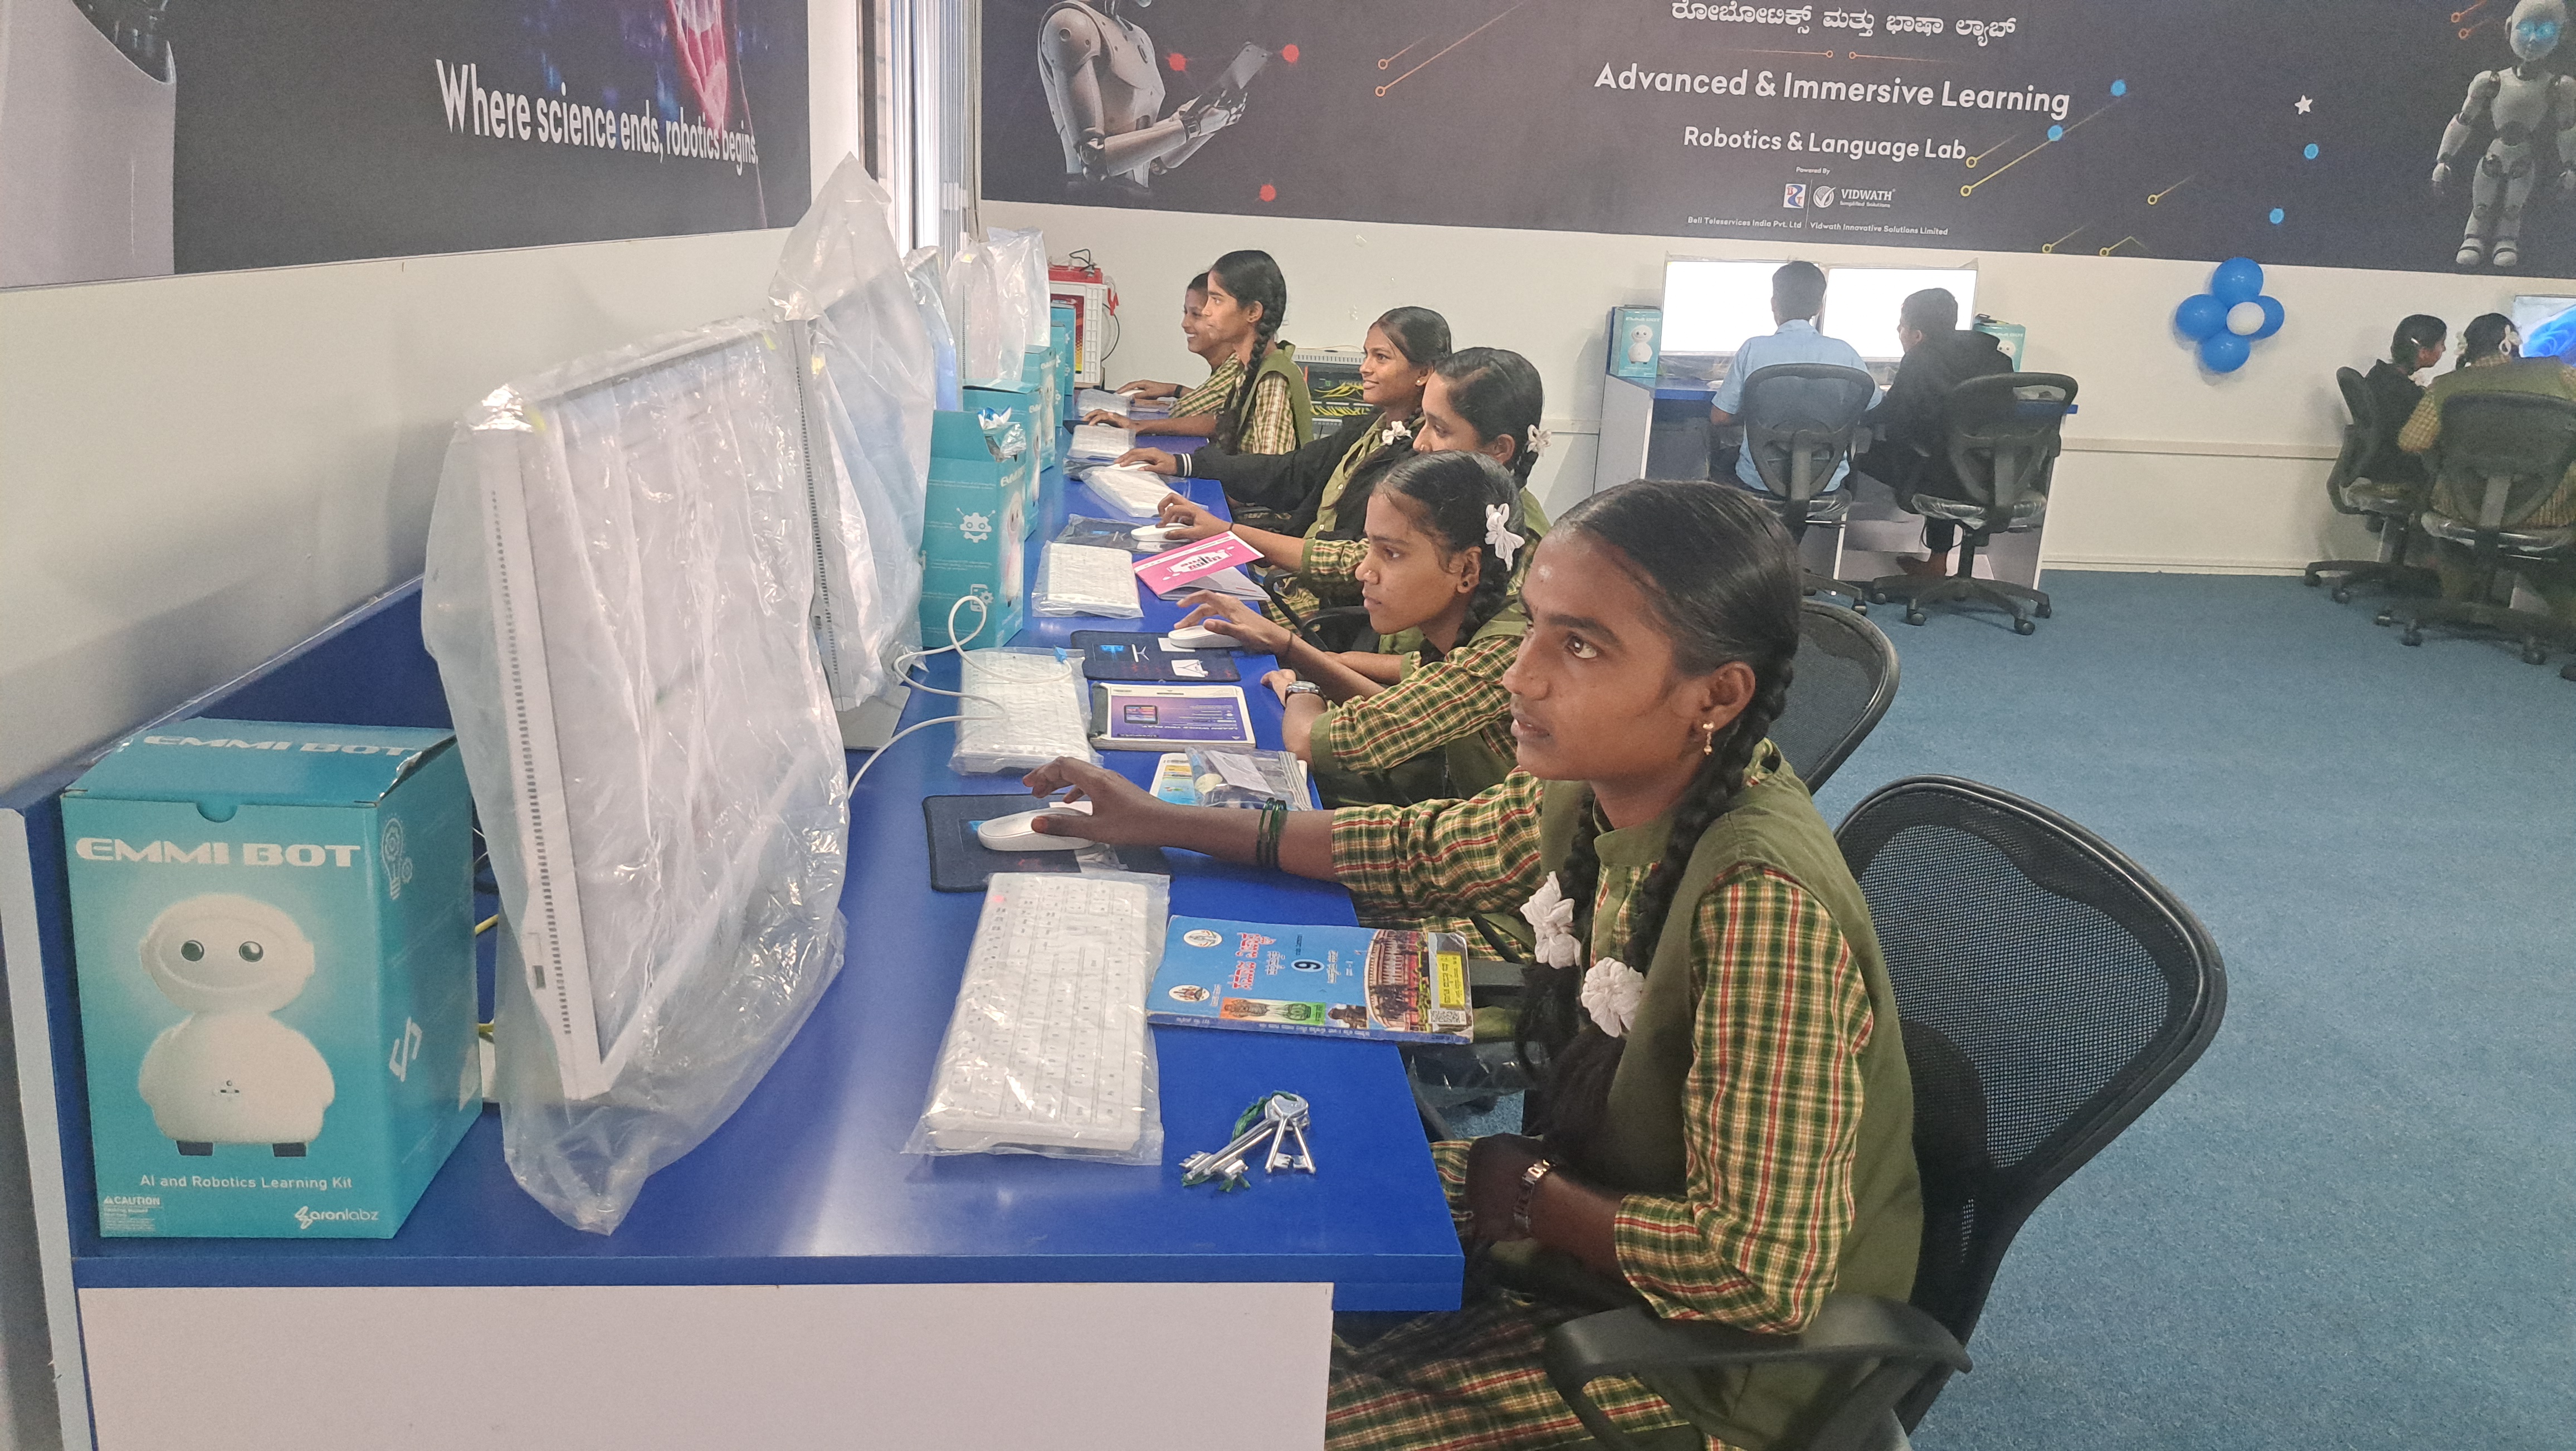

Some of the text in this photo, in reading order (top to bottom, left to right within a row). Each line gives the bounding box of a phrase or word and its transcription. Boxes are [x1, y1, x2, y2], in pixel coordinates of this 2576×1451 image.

[1823, 7, 1875, 37] ಮತ್ತು
[1886, 14, 1944, 37] ಭಾಷಾ
[1955, 17, 2017, 47] ಲ್ಯಾಬ್
[1594, 62, 2070, 120] Advanced & Immersive Learning
[436, 59, 758, 176] Where science ends, robotics begins.
[1684, 126, 1967, 162] Robotics & Language Lab
[1841, 188, 1892, 201] VIDWATH
[1705, 217, 1750, 226] Teleservices
[1752, 219, 1772, 227] India
[1810, 222, 1948, 236] Vidwath Innovative Solutions Limited
[143, 736, 419, 756] EMMI BOT
[76, 837, 360, 867] EMMI BOT
[140, 1175, 352, 1190] AI and Robotics Learning Kit
[114, 1196, 160, 1205] CAUTION
